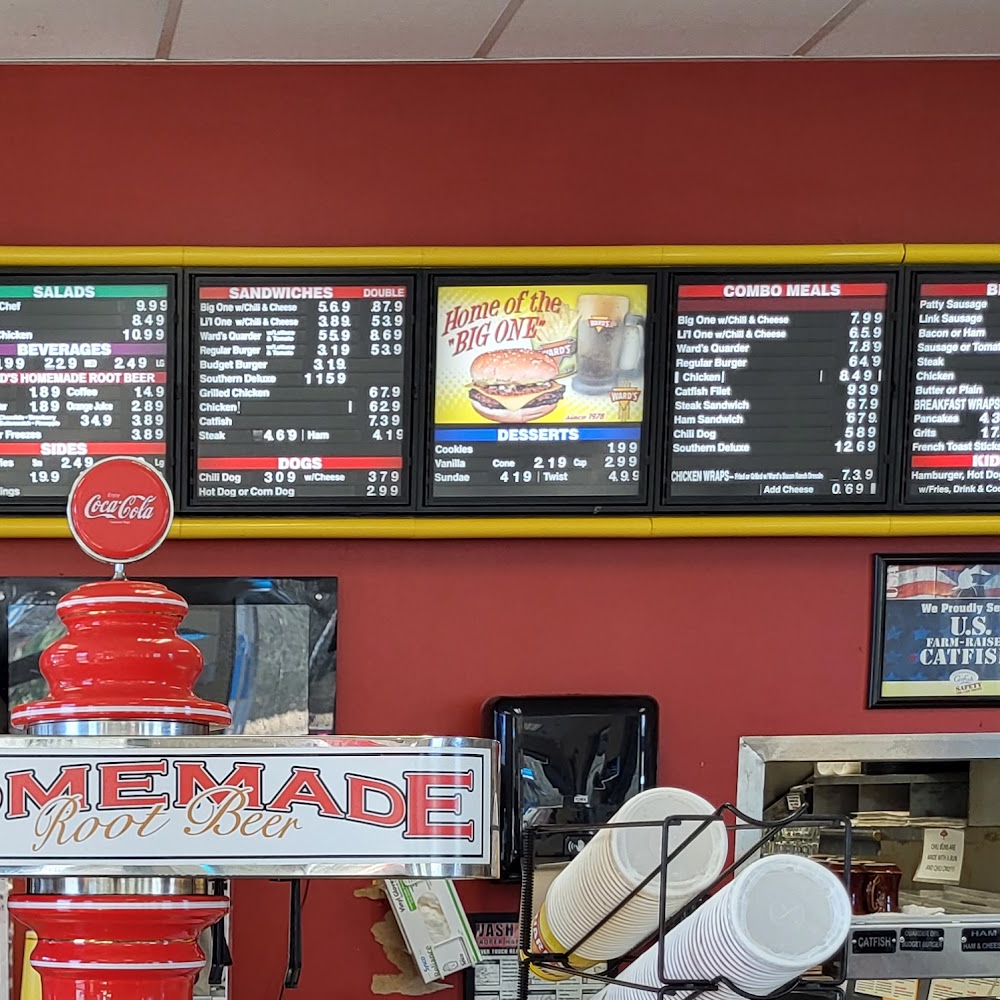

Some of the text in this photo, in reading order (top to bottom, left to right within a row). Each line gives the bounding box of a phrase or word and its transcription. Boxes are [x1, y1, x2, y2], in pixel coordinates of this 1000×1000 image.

[33, 286, 95, 298] SALADS
[229, 287, 405, 299] SANDWICHES DOUBLE
[723, 285, 841, 297] COMBO MEALS
[919, 300, 988, 310] Patty Sausage
[441, 290, 562, 337] Home of the
[678, 316, 789, 326] Big One w/Chili & Cheese
[919, 314, 983, 324] Link Sausage
[200, 332, 227, 342] Ward's
[228, 332, 262, 342] Quarder
[918, 328, 986, 338] Bacon or Ham
[17, 344, 112, 356] BEVERAGES
[200, 346, 231, 357] Regular
[232, 346, 261, 357] Burger
[676, 344, 750, 354] Ward's Quarder
[200, 360, 268, 371] Budget Burger
[676, 358, 748, 369] Regular Burger
[917, 357, 945, 366] Steak
[21, 373, 87, 383] HOMEMADE
[89, 373, 122, 383] ROOT
[124, 373, 155, 383] BEER
[200, 374, 277, 384] Southern Deluxe
[682, 372, 721, 382] Chicken
[916, 371, 954, 381] Chicken
[66, 387, 98, 397] Coffee
[200, 388, 270, 398] Grilled Chicken
[675, 387, 731, 396] Catfish Filet
[915, 385, 983, 395] Butter or Plain
[611, 392, 639, 401] WARD'S
[675, 401, 750, 410] Steak Sandwich
[914, 399, 966, 410] BREAKFAST
[199, 417, 232, 426] Catfish
[674, 415, 744, 424] Ham Sandwich
[914, 414, 960, 424] Pancakes
[5, 430, 42, 440] Freezes
[199, 431, 226, 440] Steak
[307, 431, 330, 440] Ham
[497, 429, 579, 441] DESSERTS
[673, 429, 717, 439] Chili Dog
[913, 428, 936, 438] Grits
[40, 443, 88, 455] SIDES
[435, 445, 474, 454] Cookies
[673, 443, 750, 453] Southern Deluxe
[278, 458, 323, 469] DOGS
[435, 459, 516, 468] Vanilla Cone
[573, 458, 587, 468] Cup
[199, 473, 242, 483] Chili Dog
[304, 473, 345, 482] w/Cheese
[434, 473, 470, 482] Sundae
[543, 472, 568, 482] Twist
[199, 487, 295, 497] Hot Dog or Corn Dog
[764, 485, 814, 494] Add Cheese
[921, 603, 937, 613] We
[941, 603, 983, 615] Proudly
[950, 616, 991, 636] U.S.
[920, 649, 1000, 665] CATFIS
[32, 785, 302, 852] Root Beer
[858, 937, 891, 947] CATFISH
